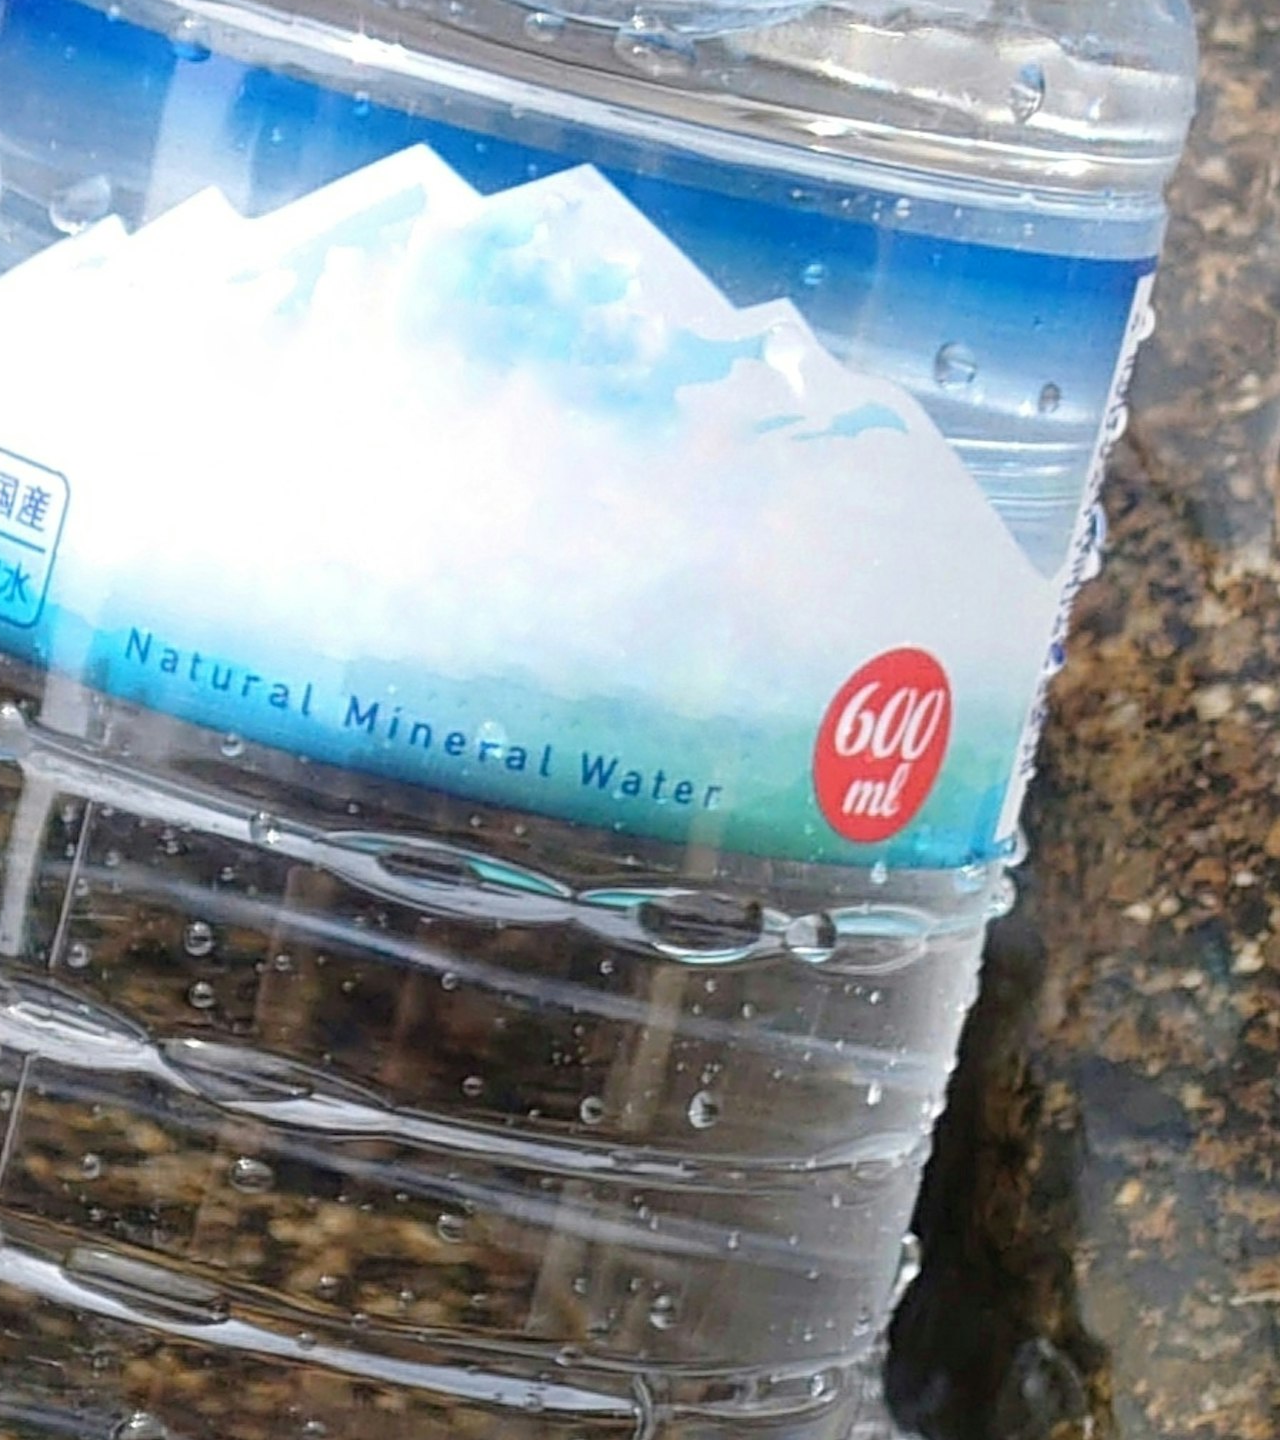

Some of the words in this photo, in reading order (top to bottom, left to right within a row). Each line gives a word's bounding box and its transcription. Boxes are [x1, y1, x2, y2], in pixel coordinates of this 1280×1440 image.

[124, 626, 313, 716] Natural
[344, 695, 553, 777] Mineral
[581, 752, 723, 809] Water
[834, 681, 946, 761] 600
[842, 761, 912, 818] ml
